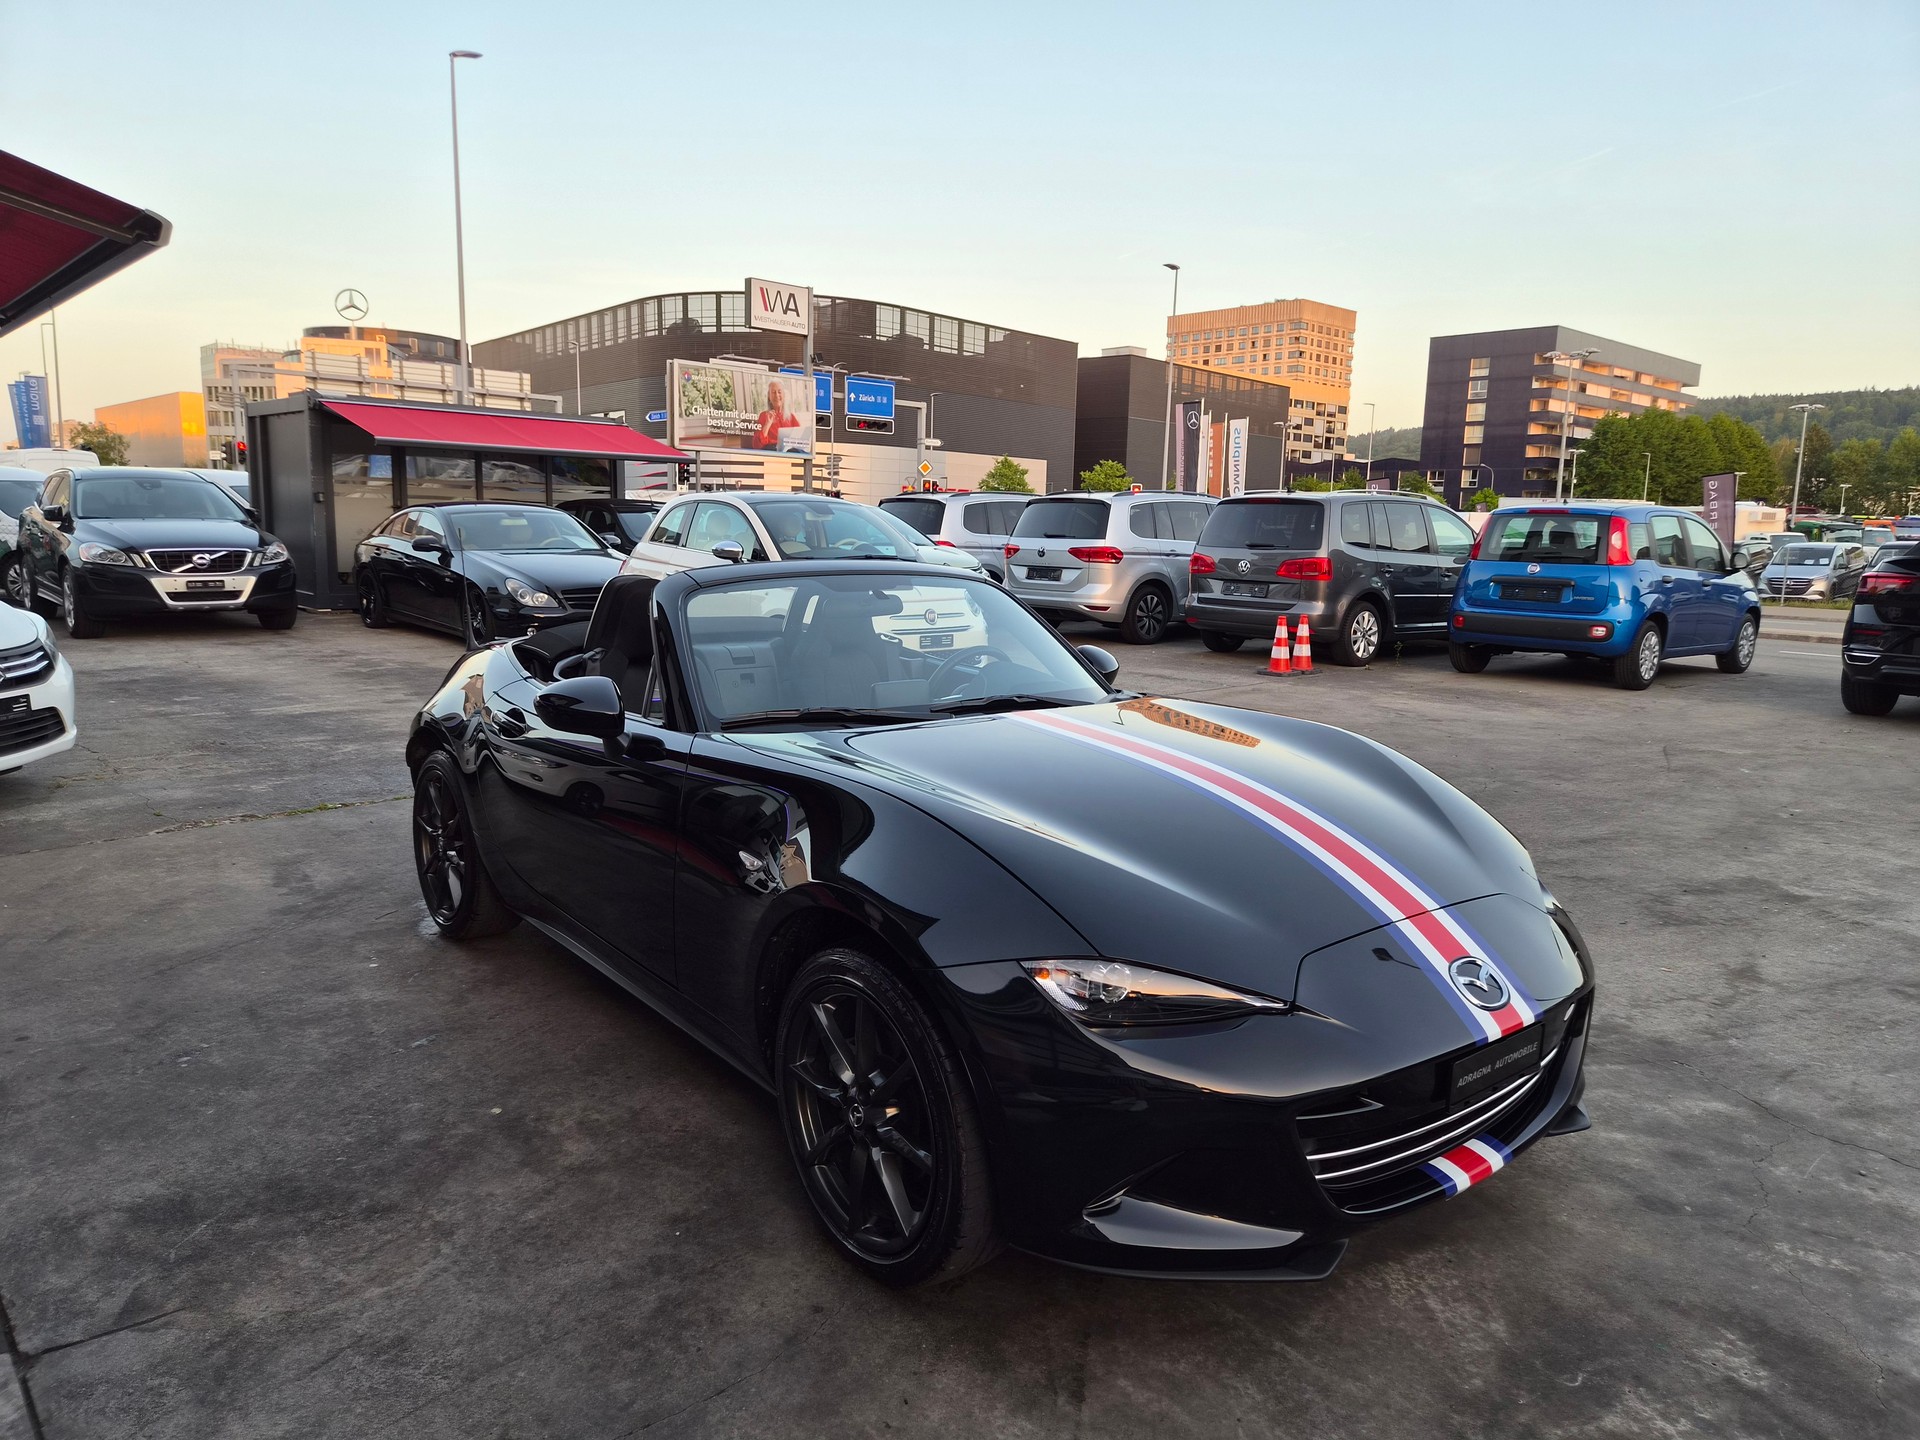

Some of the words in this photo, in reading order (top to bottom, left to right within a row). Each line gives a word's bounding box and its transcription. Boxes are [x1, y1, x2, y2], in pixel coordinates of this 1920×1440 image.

[858, 393, 875, 402] Zürich
[692, 405, 724, 417] Chatten
[725, 408, 739, 419] mit
[740, 410, 759, 421] dem
[707, 416, 734, 428] besten
[735, 419, 763, 431] Service
[1456, 1064, 1492, 1088] ADRAGNA
[1494, 1041, 1539, 1070] AUTOMOBILE
